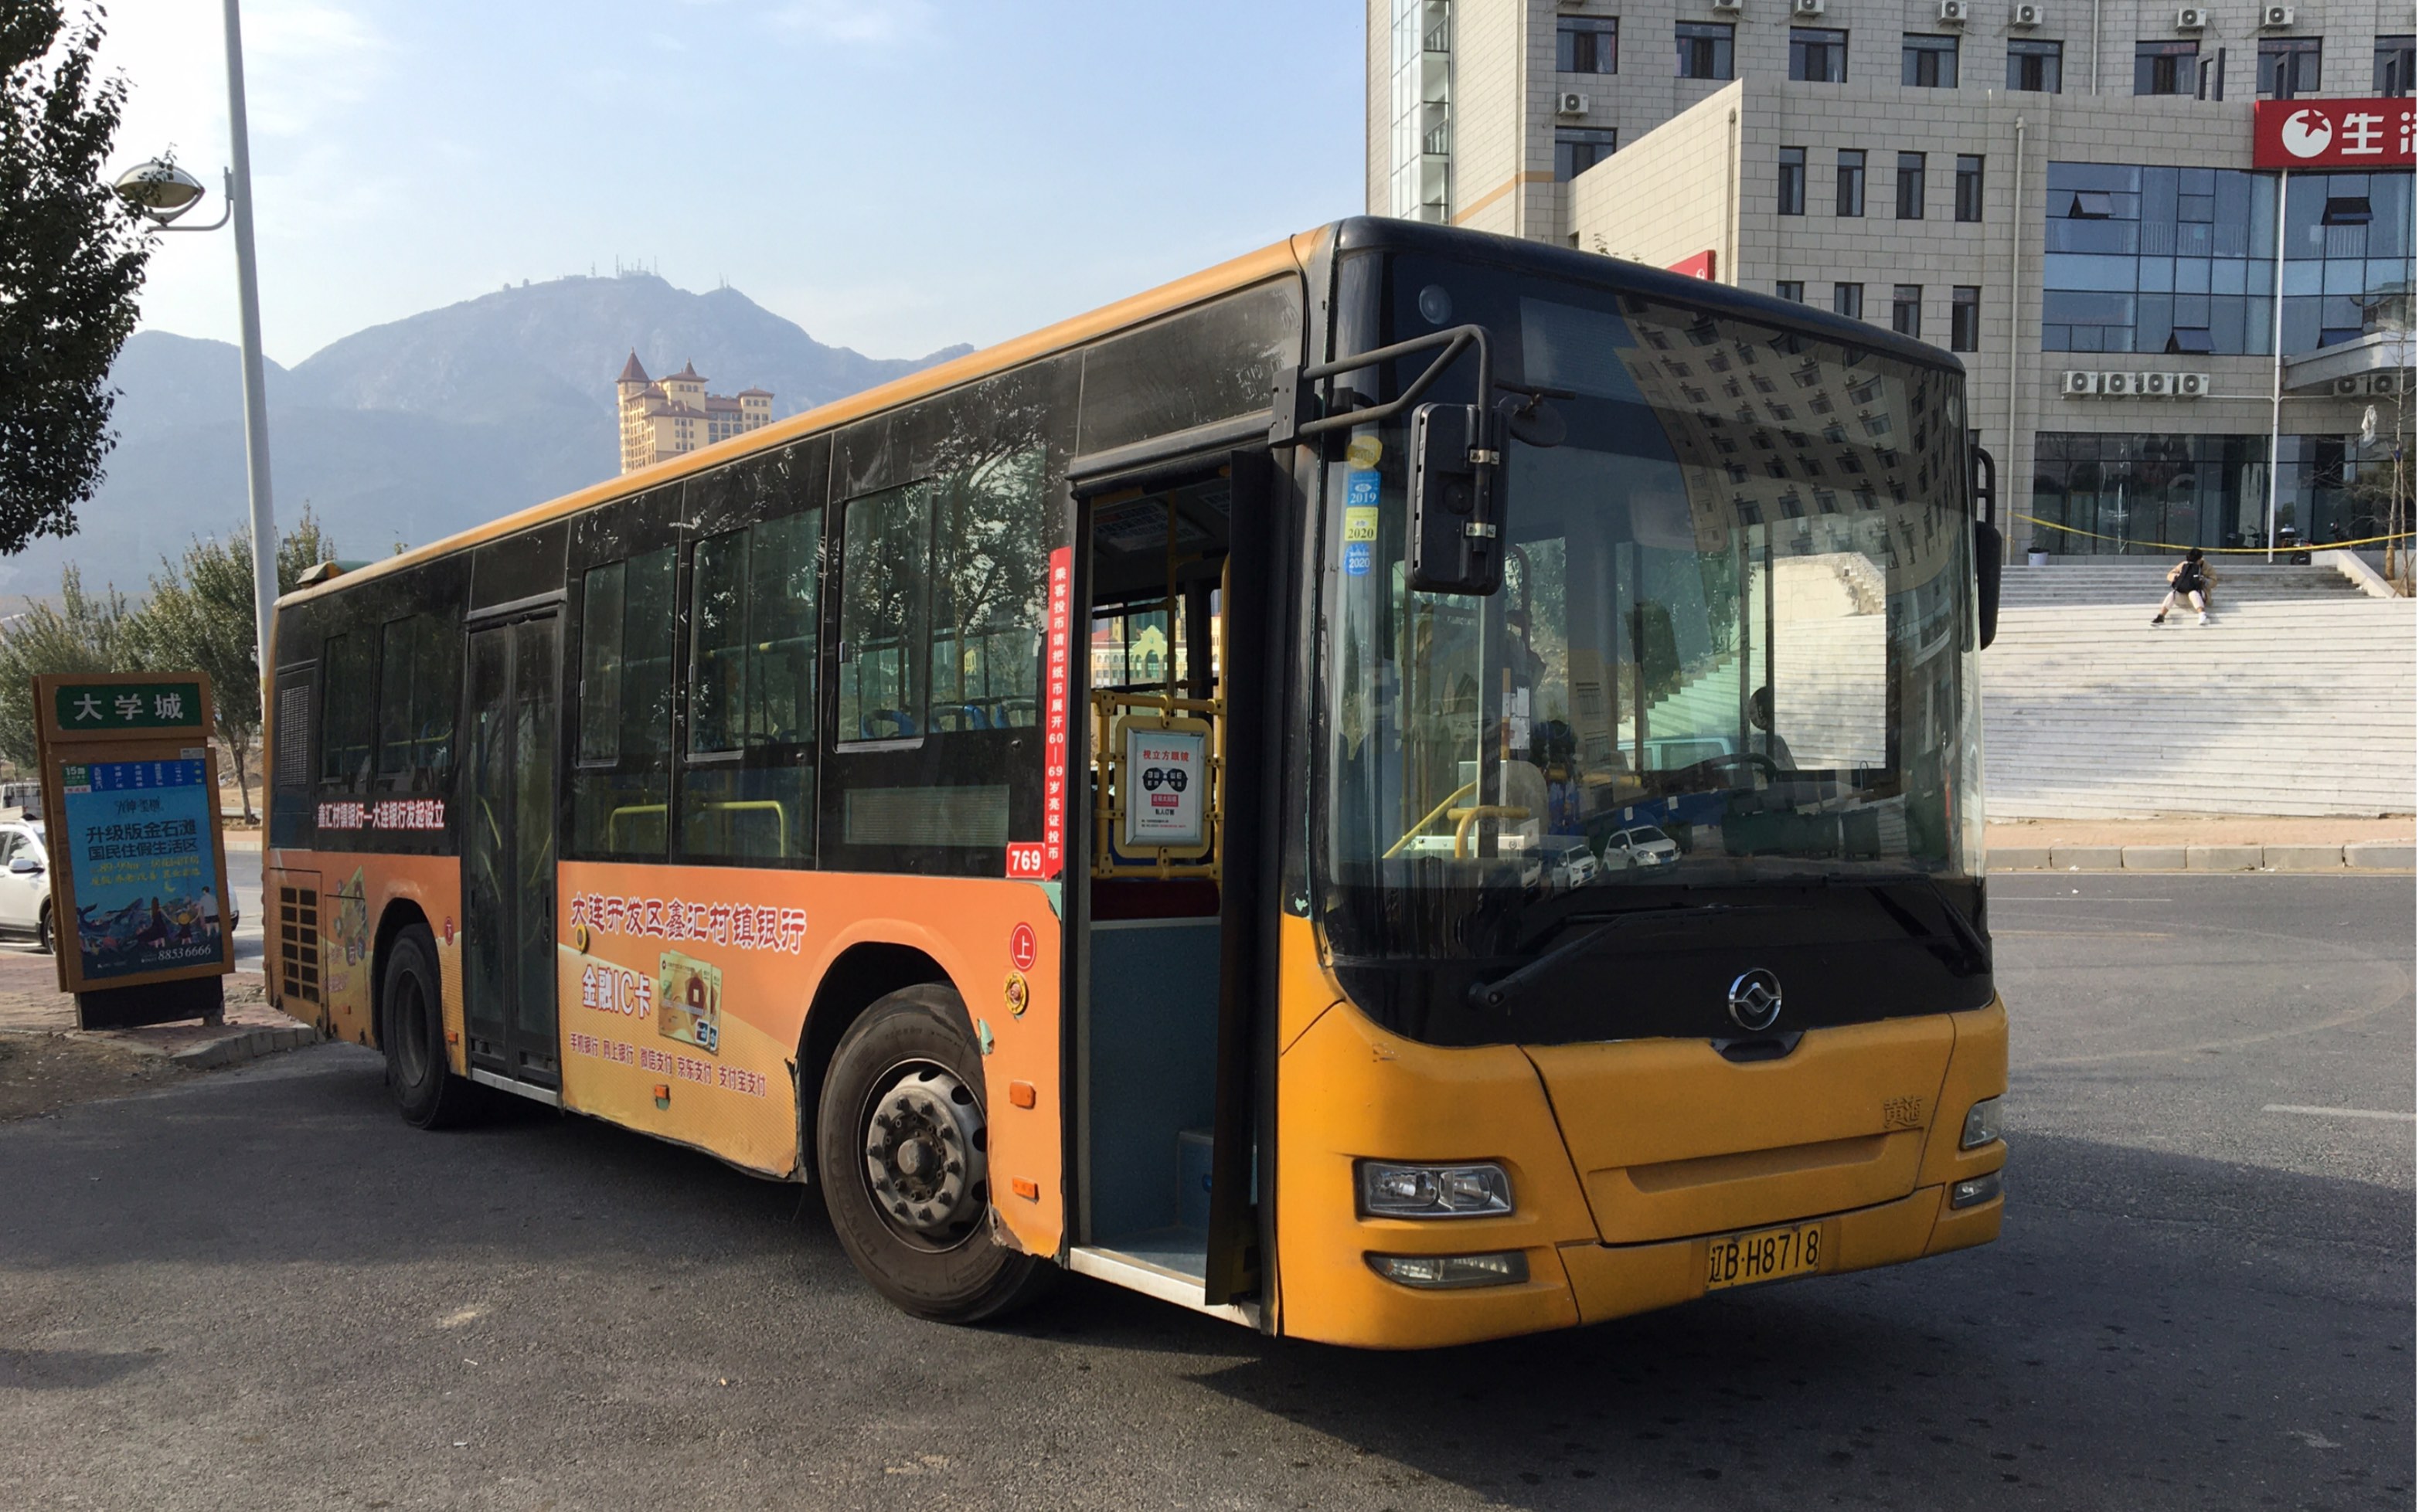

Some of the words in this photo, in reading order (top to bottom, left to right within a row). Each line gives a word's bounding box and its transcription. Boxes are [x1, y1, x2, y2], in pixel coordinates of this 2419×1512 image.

[1350, 492, 1377, 504] 2019
[1348, 528, 1374, 539] 2020
[1349, 557, 1370, 569] 2020
[73, 692, 184, 721] 大学城
[87, 819, 197, 844] 升级版金石滩
[88, 838, 199, 861] 国民住假生活区
[1011, 850, 1041, 871] 769
[571, 892, 807, 955] 大连开发区鑫汇村镇银行
[1016, 935, 1031, 960] 上
[582, 965, 652, 1018] 金融IC卡
[570, 1032, 599, 1058] 手机银行
[603, 1040, 634, 1065] 网上银行
[640, 1047, 672, 1075] 微信支付
[677, 1056, 712, 1085] 京东支付
[718, 1065, 767, 1097] 支付宝支付
